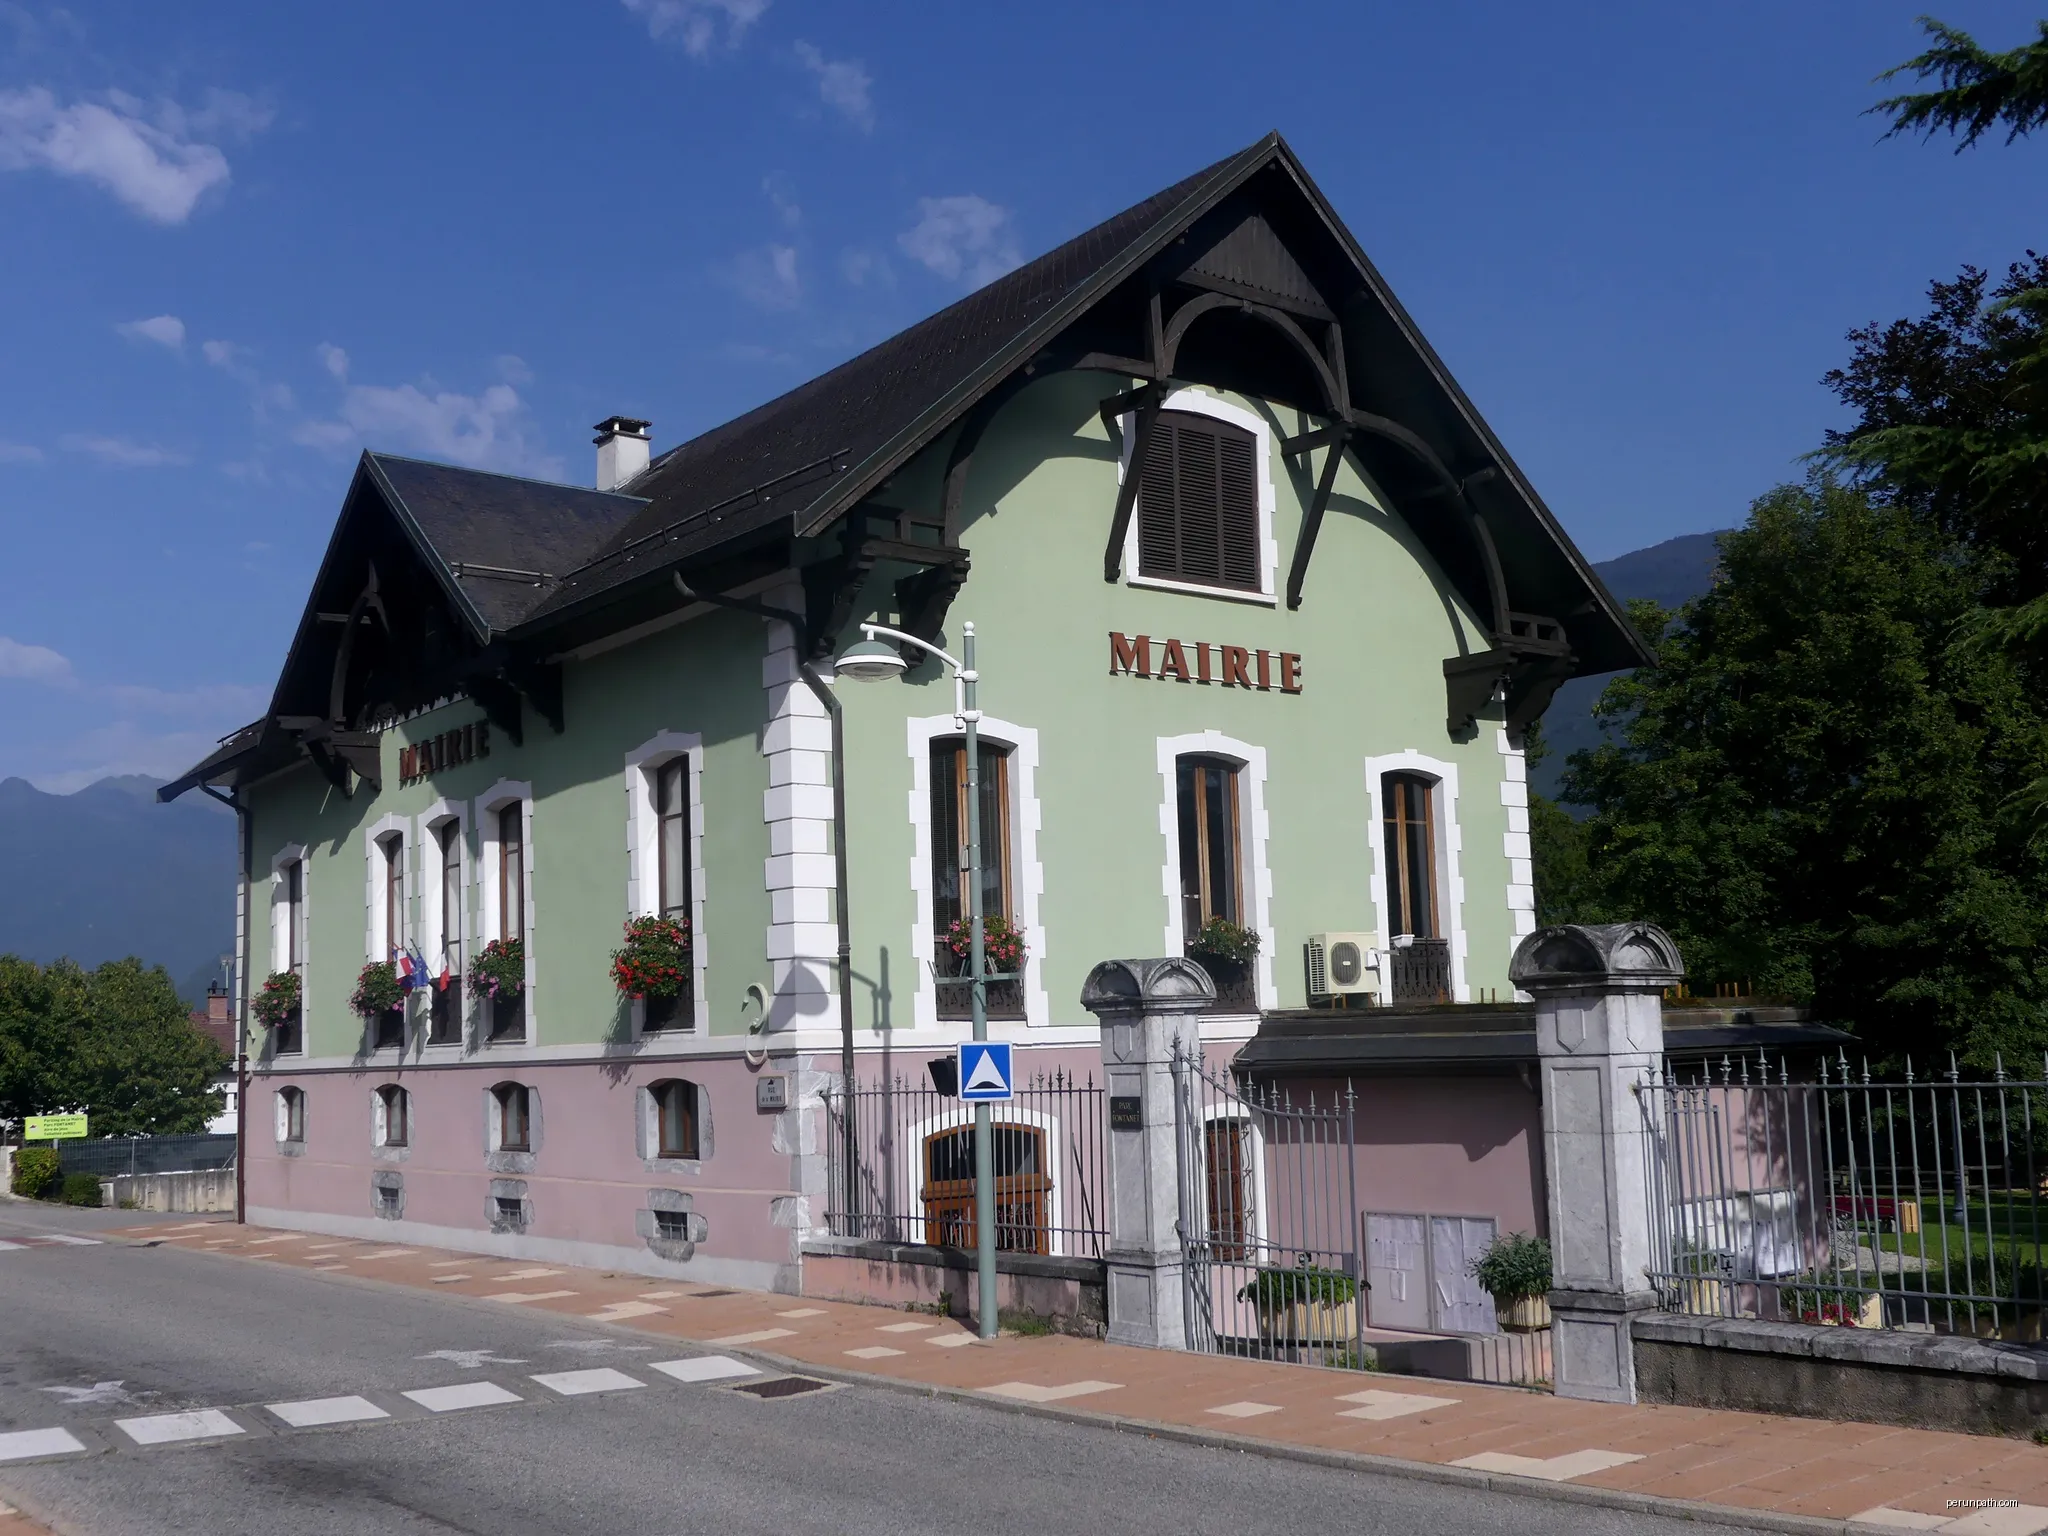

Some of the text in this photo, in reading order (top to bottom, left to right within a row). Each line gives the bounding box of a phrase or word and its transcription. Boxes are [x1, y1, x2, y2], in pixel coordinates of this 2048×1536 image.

[1108, 631, 1303, 694] MAIRIE
[399, 719, 490, 780] MAIRIE
[1112, 1114, 1140, 1122] FONTANET
[1118, 1101, 1132, 1110] PARC
